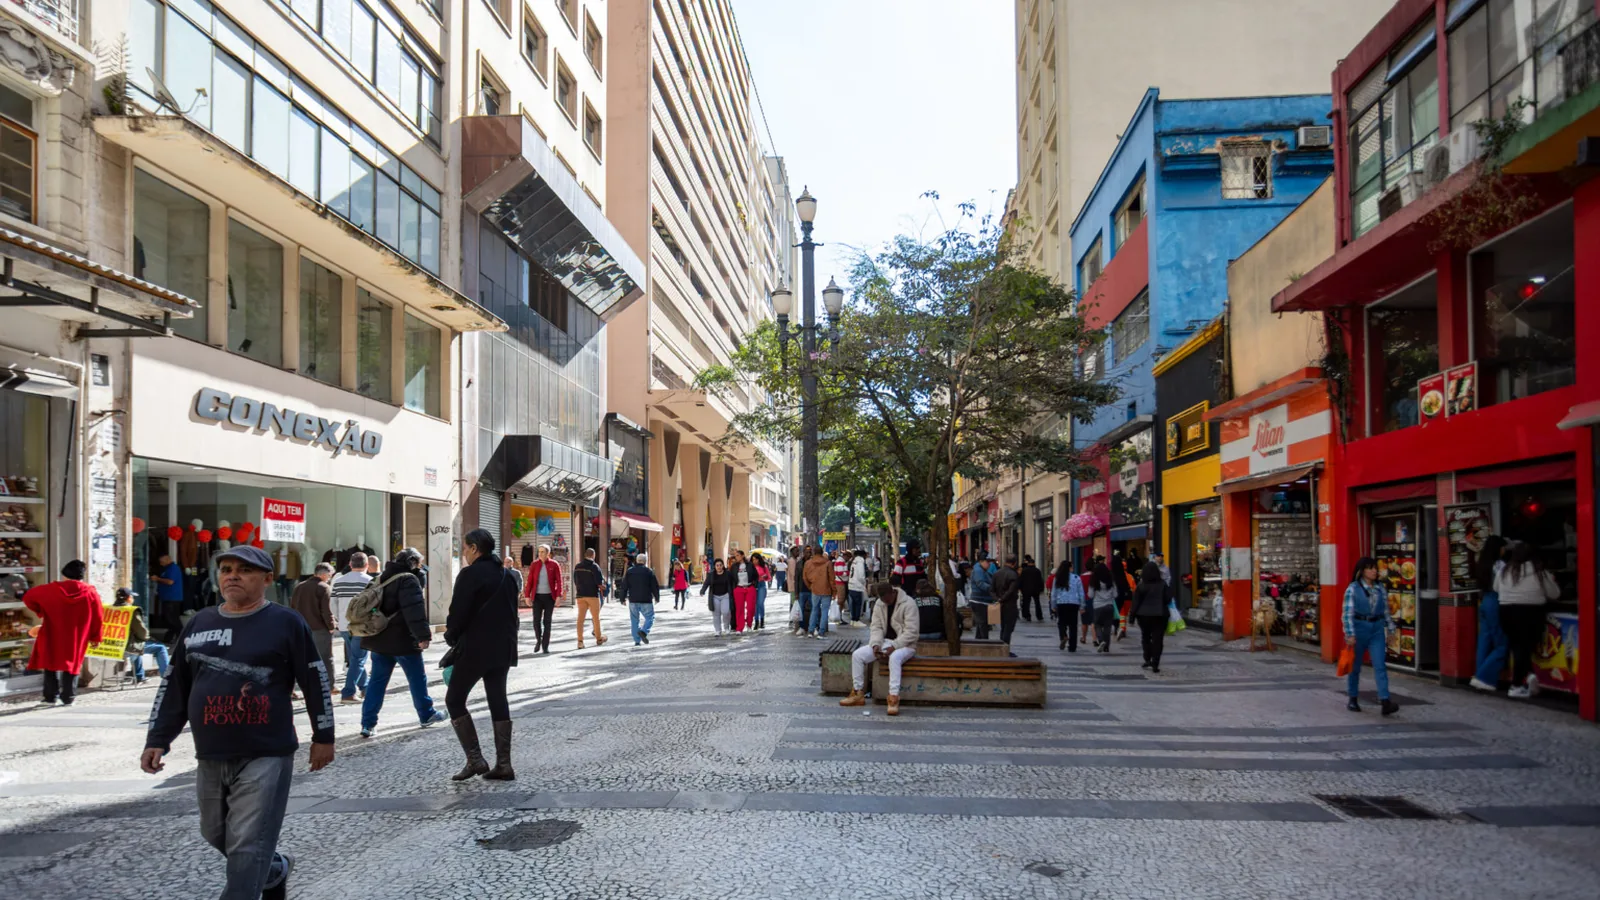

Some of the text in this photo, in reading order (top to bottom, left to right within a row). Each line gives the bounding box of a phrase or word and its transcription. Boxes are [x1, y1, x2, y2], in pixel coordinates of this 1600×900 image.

[194, 386, 383, 459] CONEXÃO
[1252, 420, 1285, 452] Lilian
[267, 503, 302, 517] AQUI TEM
[103, 608, 131, 626] URO
[203, 712, 270, 726] POWER
